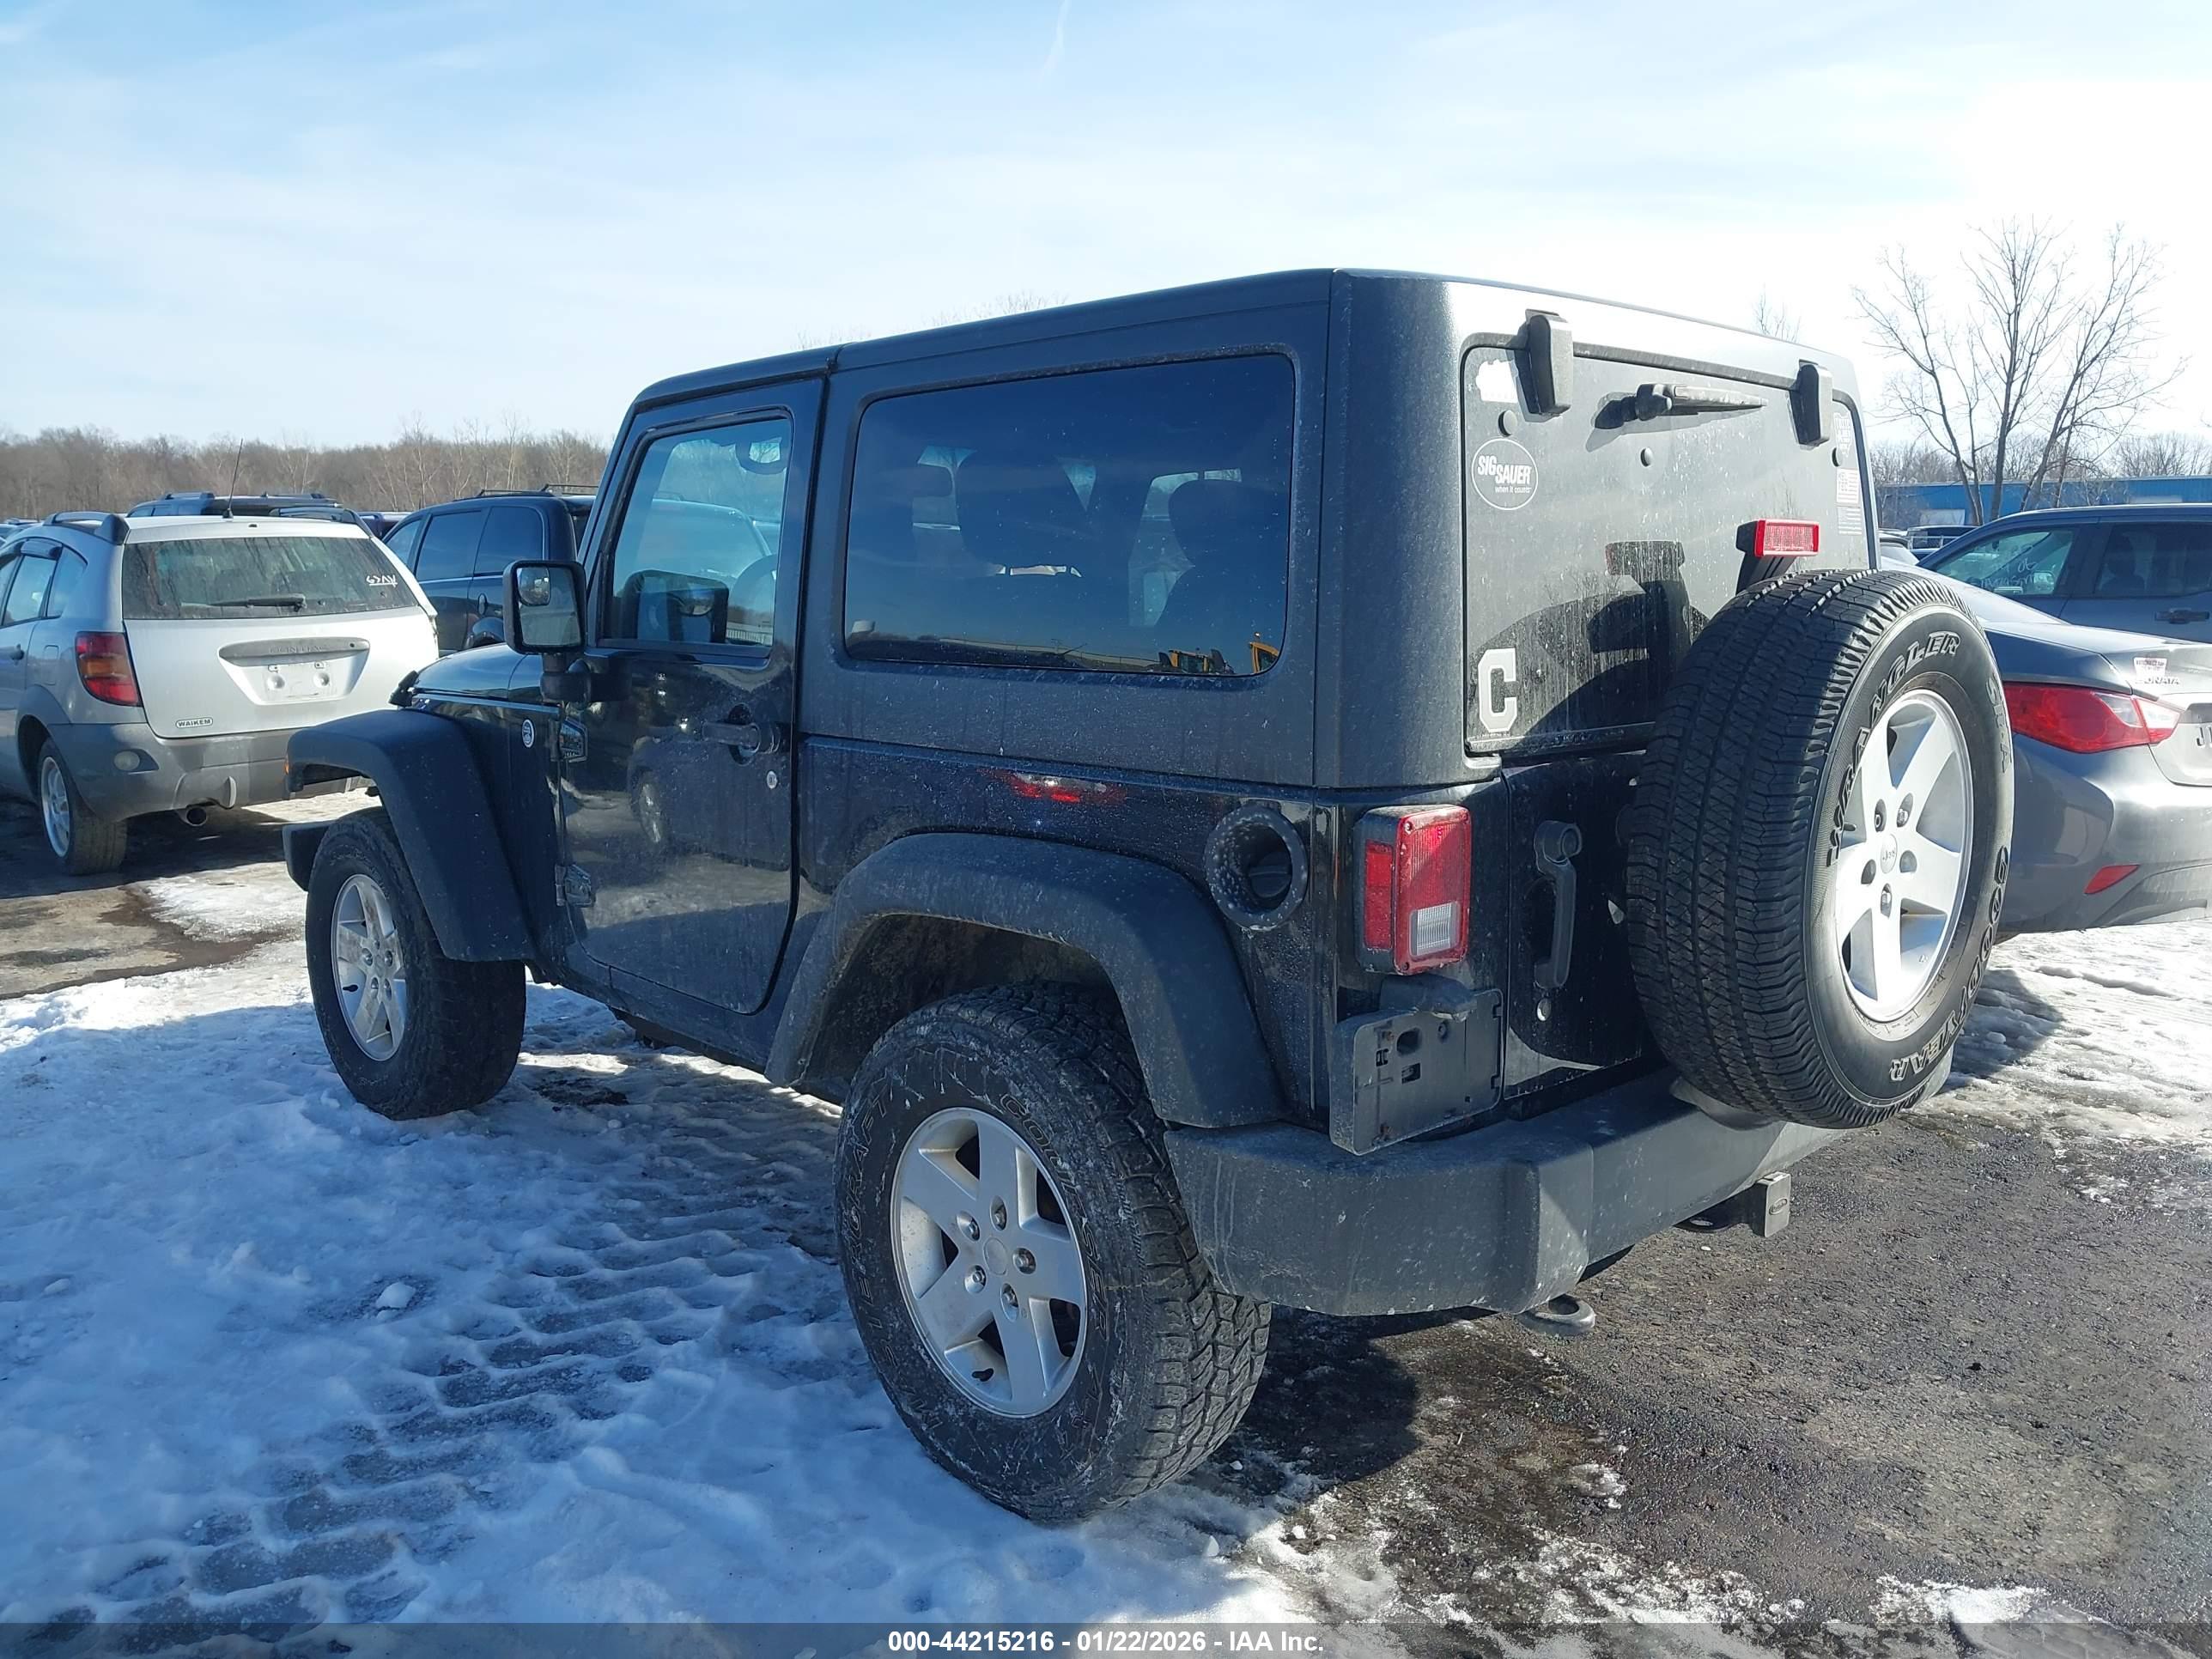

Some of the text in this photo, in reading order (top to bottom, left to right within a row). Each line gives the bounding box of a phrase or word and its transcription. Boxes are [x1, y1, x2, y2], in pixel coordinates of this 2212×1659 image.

[1478, 455, 1498, 476] SIG
[1495, 464, 1532, 485] SAUER
[1478, 647, 1517, 732] C
[1889, 845, 2010, 1085] GOODYEAR
